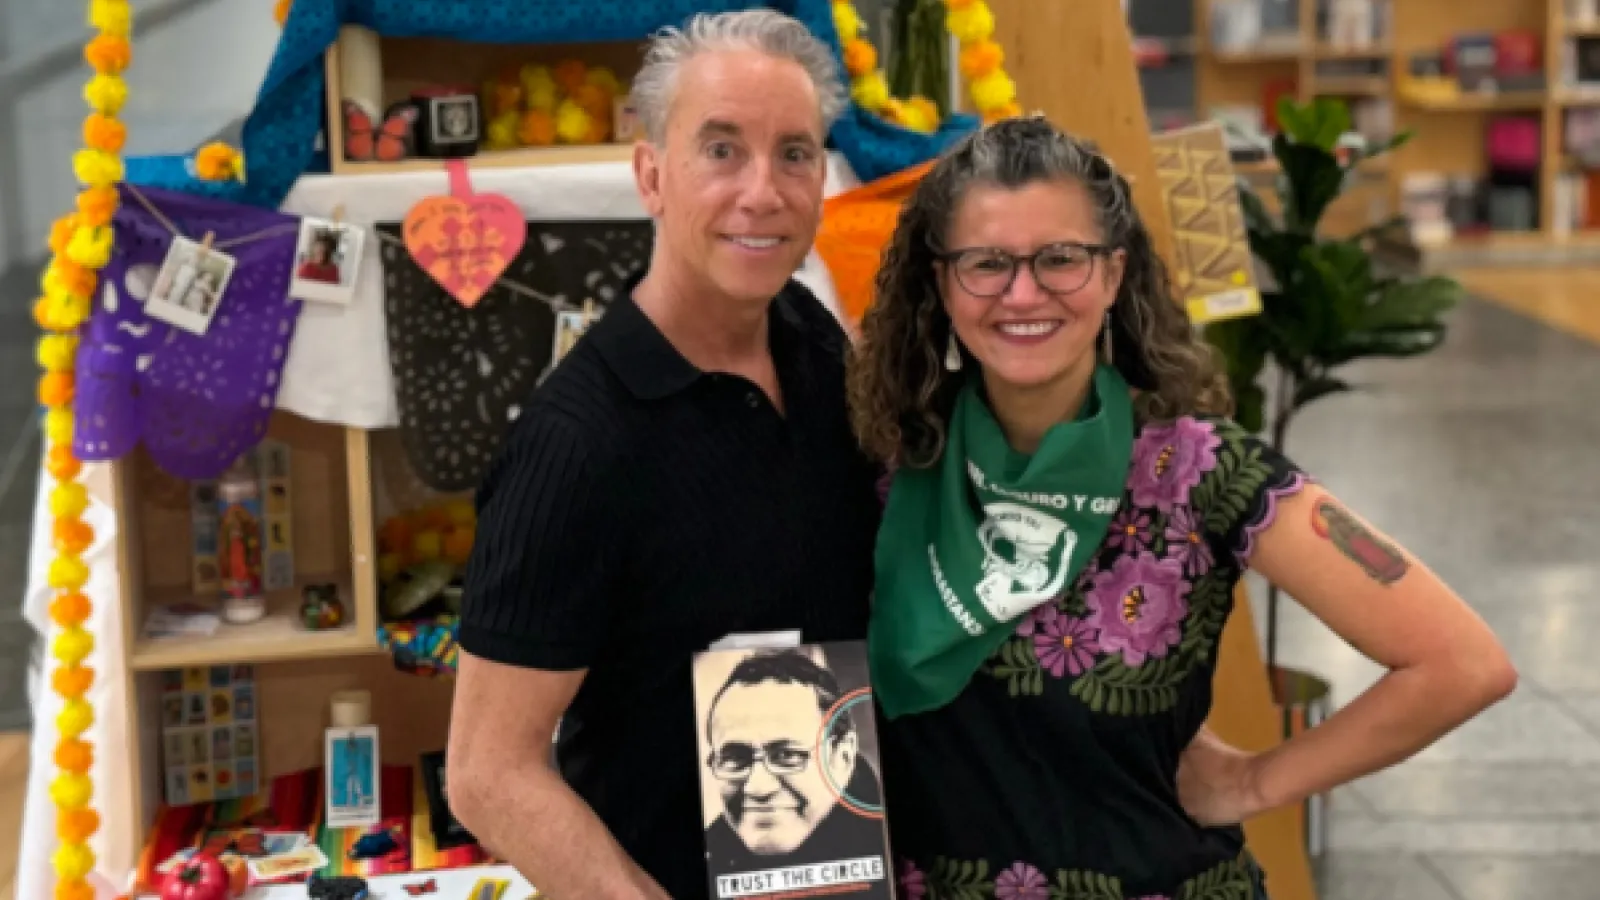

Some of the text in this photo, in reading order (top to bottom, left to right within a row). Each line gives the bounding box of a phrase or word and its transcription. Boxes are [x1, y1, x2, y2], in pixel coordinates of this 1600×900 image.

[1073, 494, 1089, 511] Y
[719, 872, 774, 894] TRUST
[782, 867, 815, 886] THE
[820, 859, 883, 883] CIRCLE
